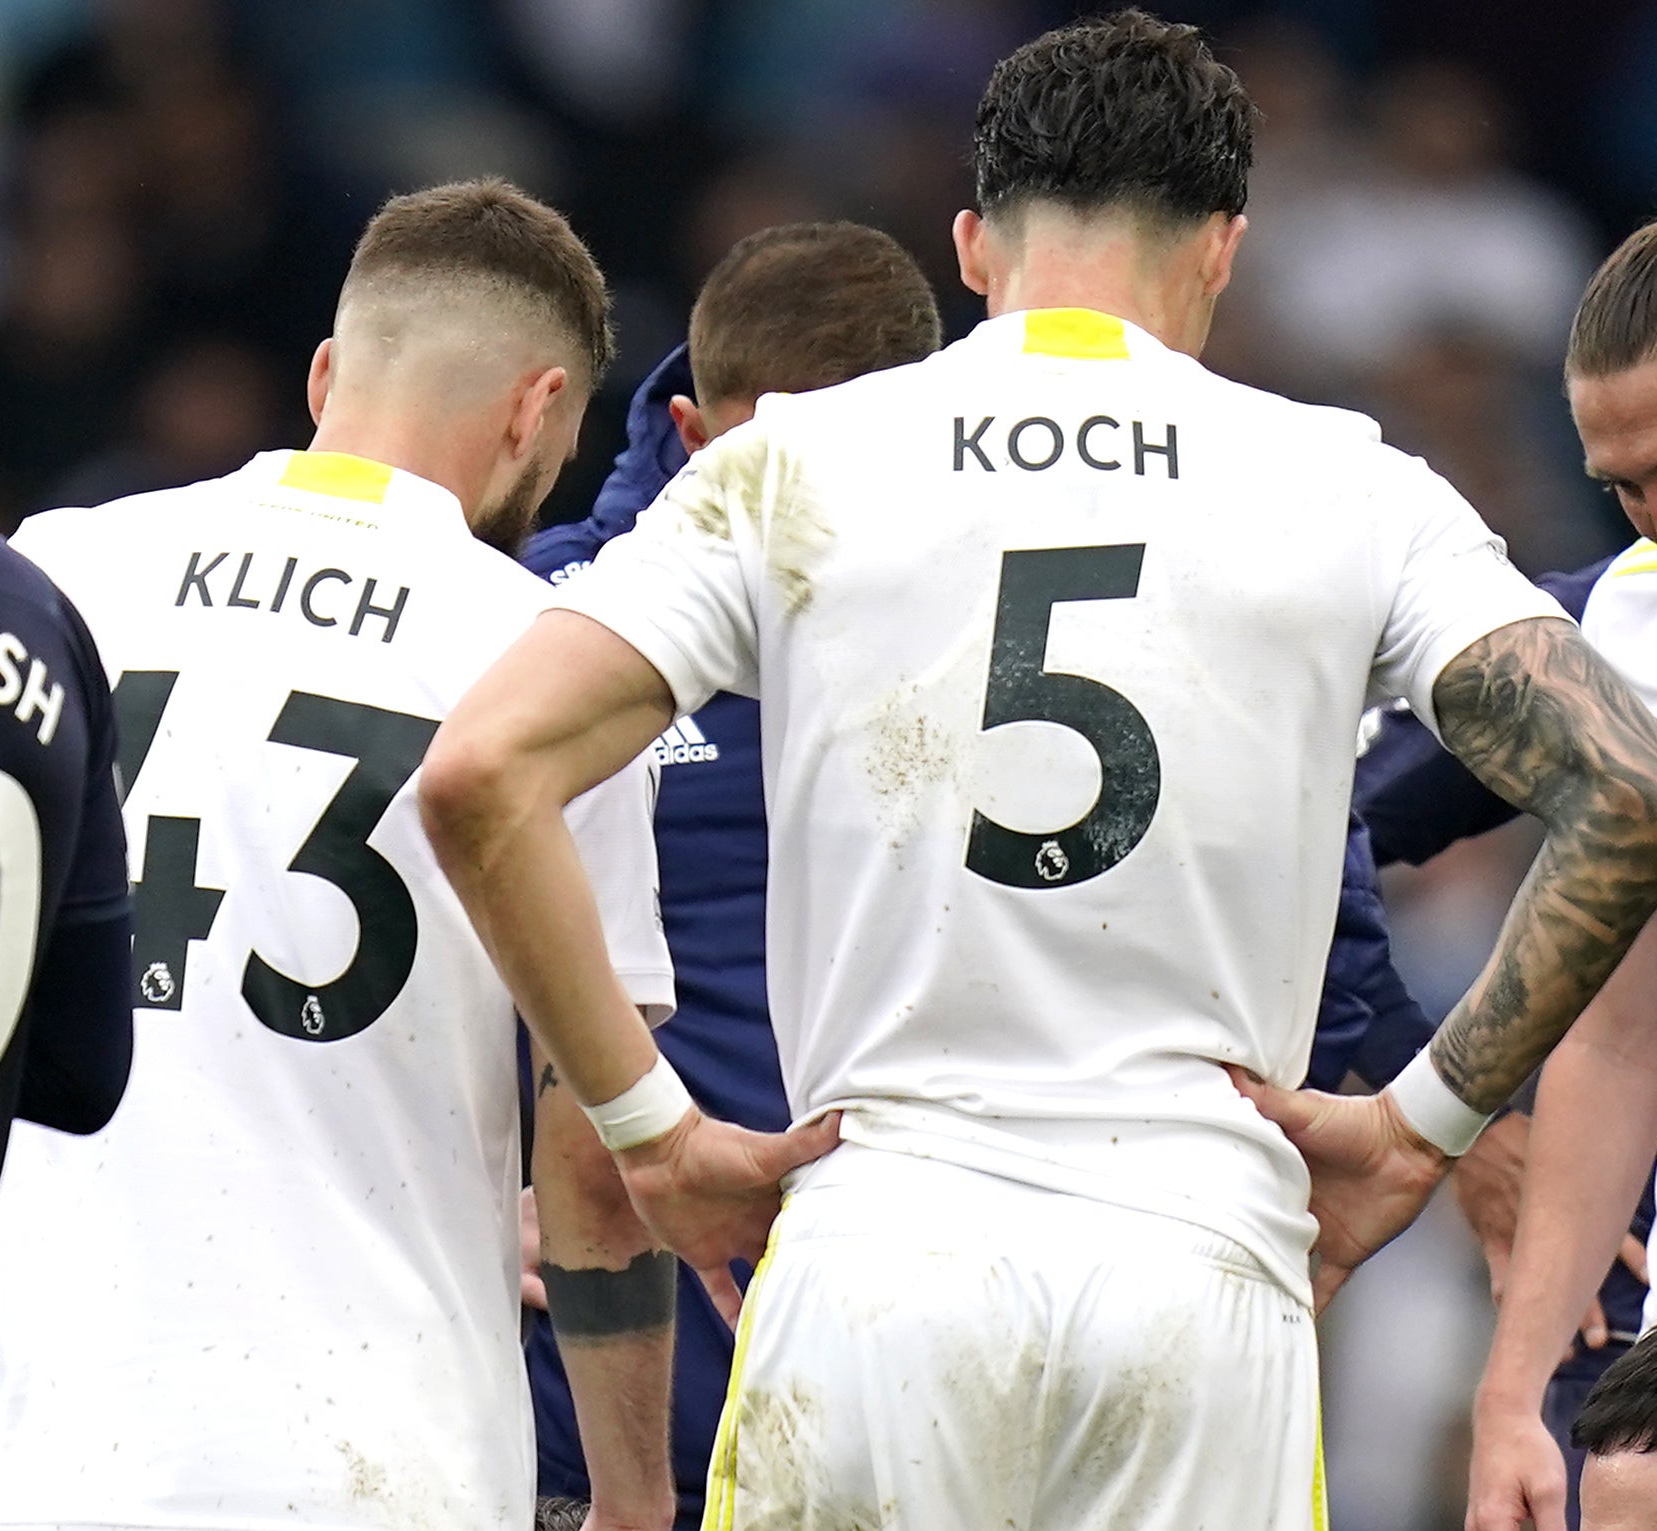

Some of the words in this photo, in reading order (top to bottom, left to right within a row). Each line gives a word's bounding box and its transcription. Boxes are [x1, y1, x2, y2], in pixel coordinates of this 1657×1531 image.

[952, 415, 1180, 480] KOCH
[174, 551, 410, 643] KLICH
[655, 742, 720, 767] didas
[963, 542, 1162, 890] 5
[110, 670, 443, 1043] 43
